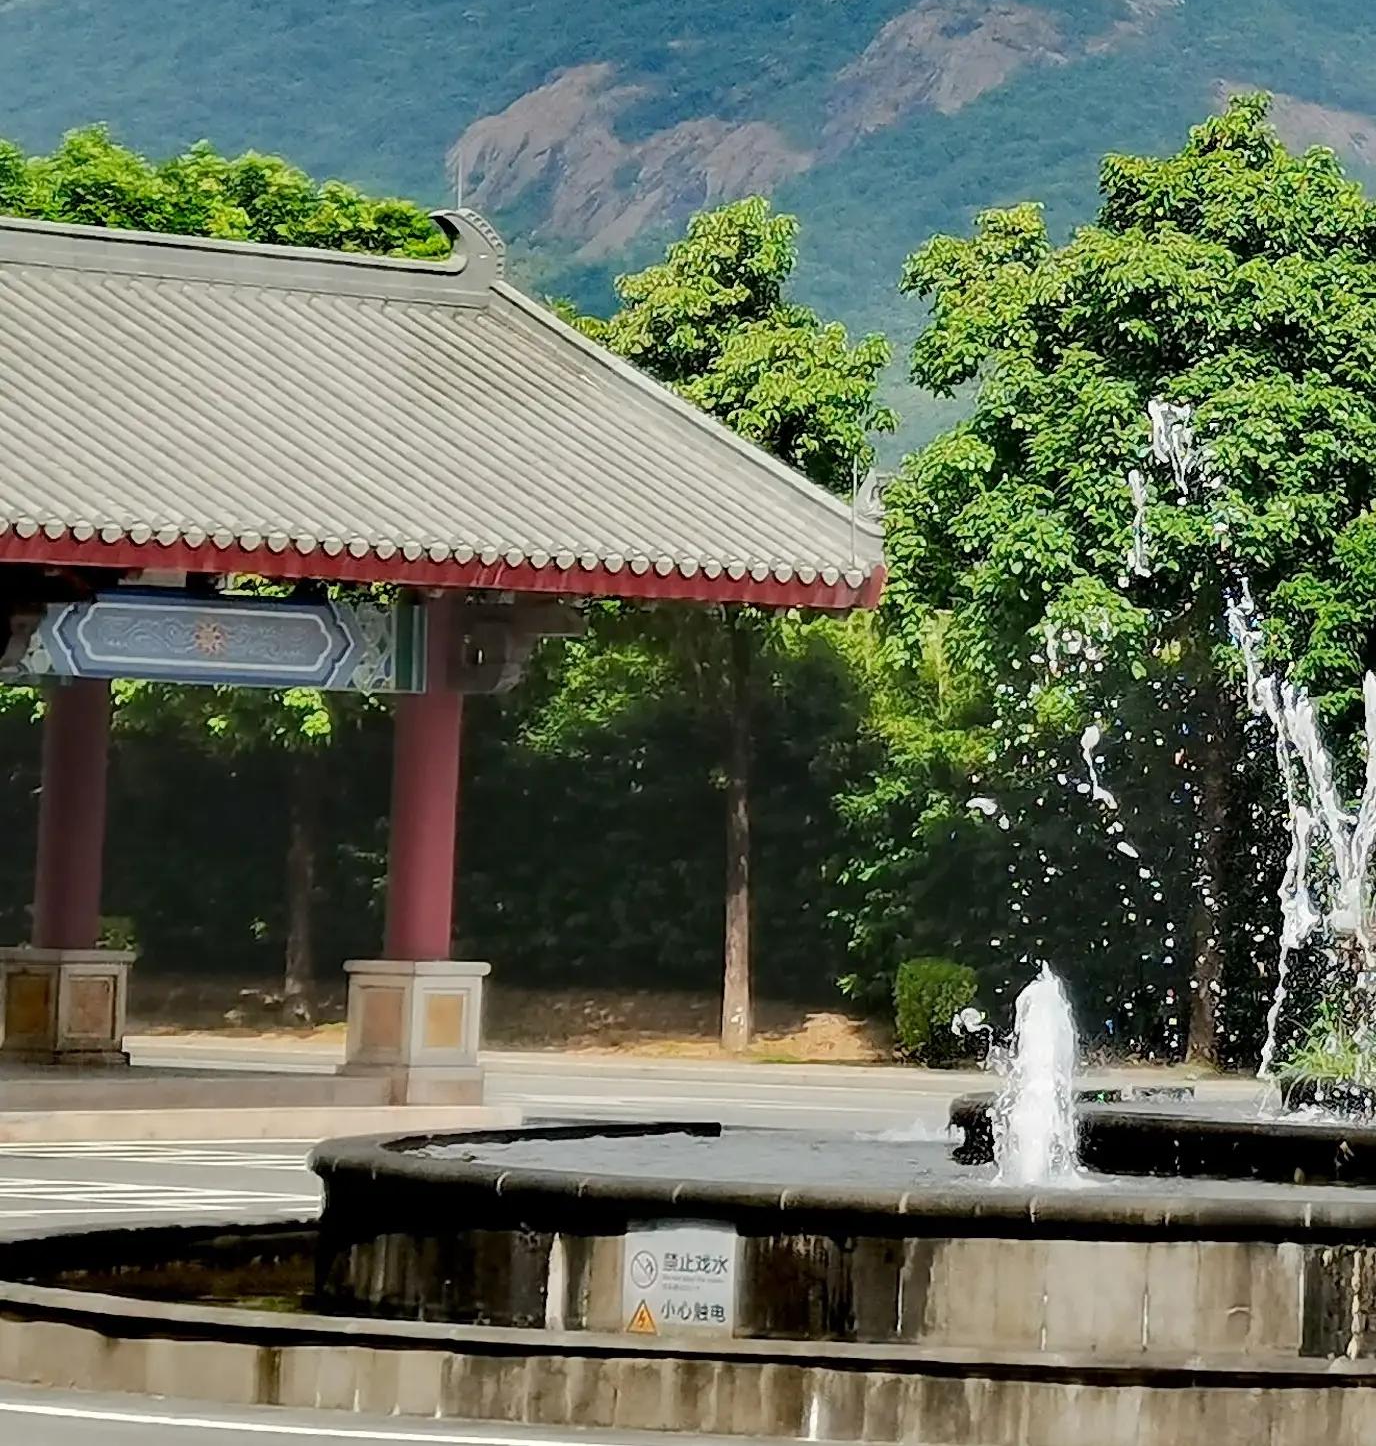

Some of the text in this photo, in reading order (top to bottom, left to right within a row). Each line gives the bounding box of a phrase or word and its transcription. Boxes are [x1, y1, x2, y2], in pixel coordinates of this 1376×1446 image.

[663, 1253, 728, 1274] 禁止戏水
[661, 1299, 726, 1323] 小心触电
